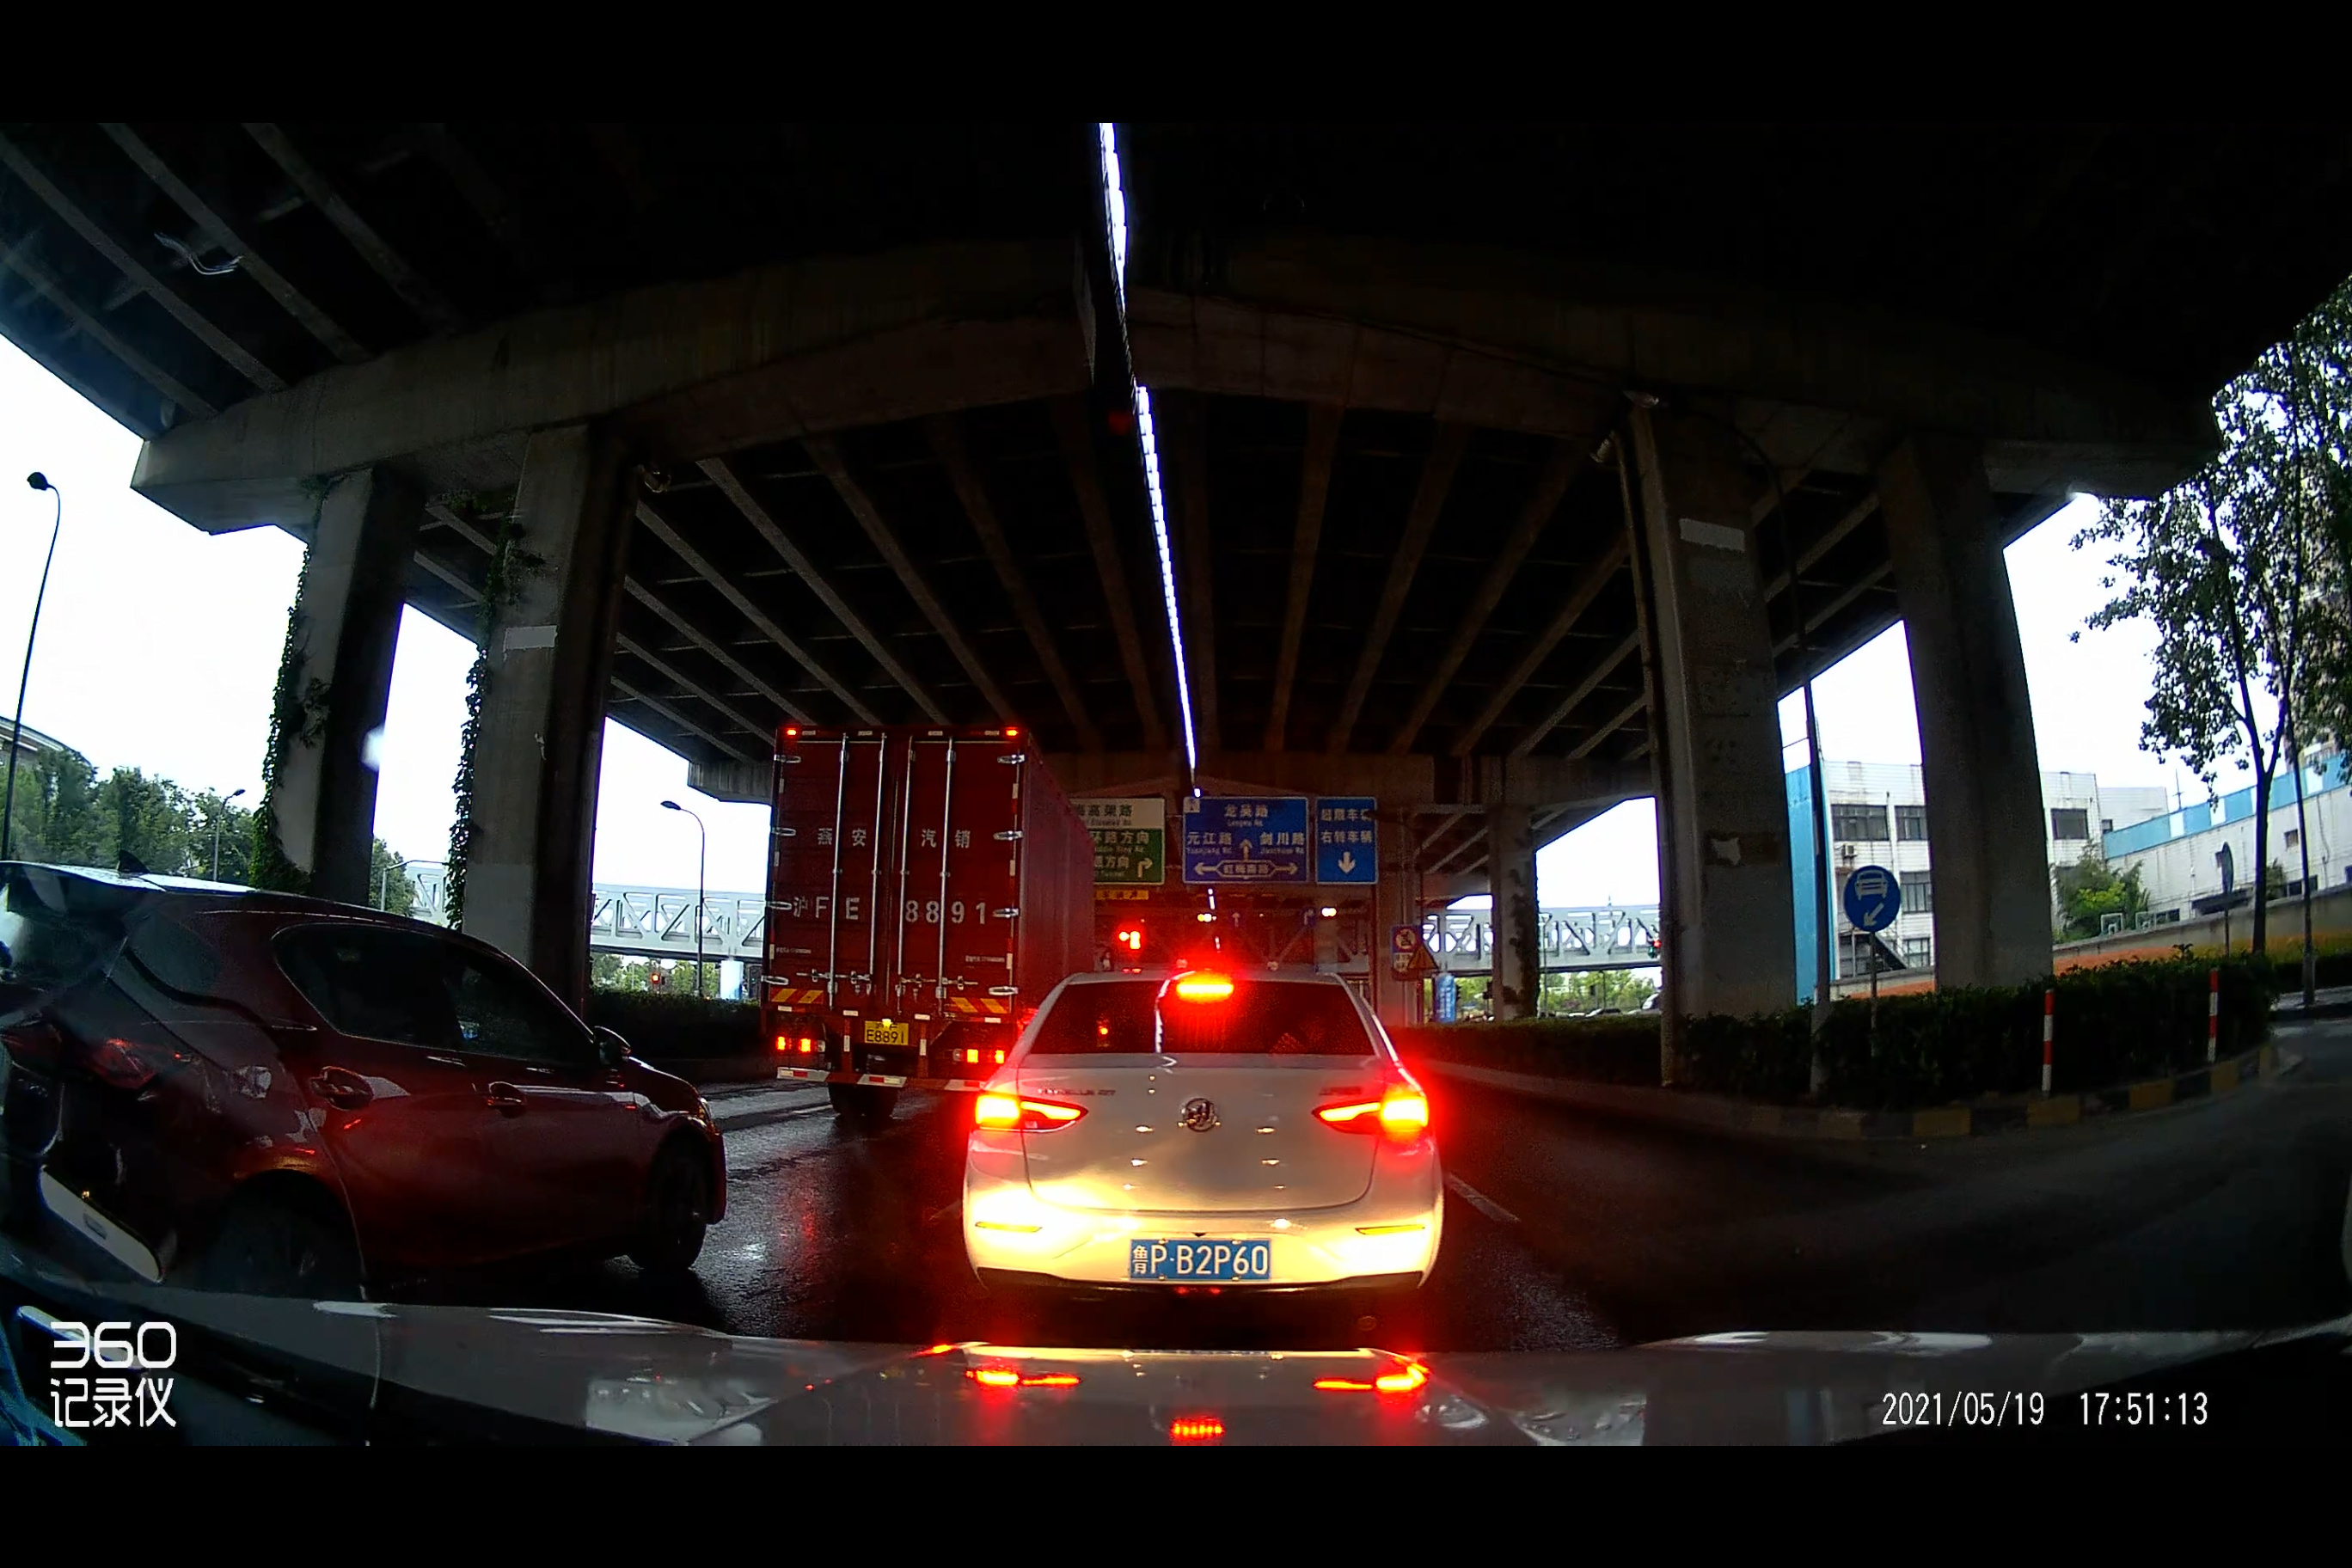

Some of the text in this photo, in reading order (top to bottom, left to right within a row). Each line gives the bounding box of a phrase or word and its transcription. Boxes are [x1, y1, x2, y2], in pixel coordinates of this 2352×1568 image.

[1186, 831, 1233, 846] 元江路
[1259, 831, 1305, 846] 剑川路
[867, 1029, 904, 1044] E8891
